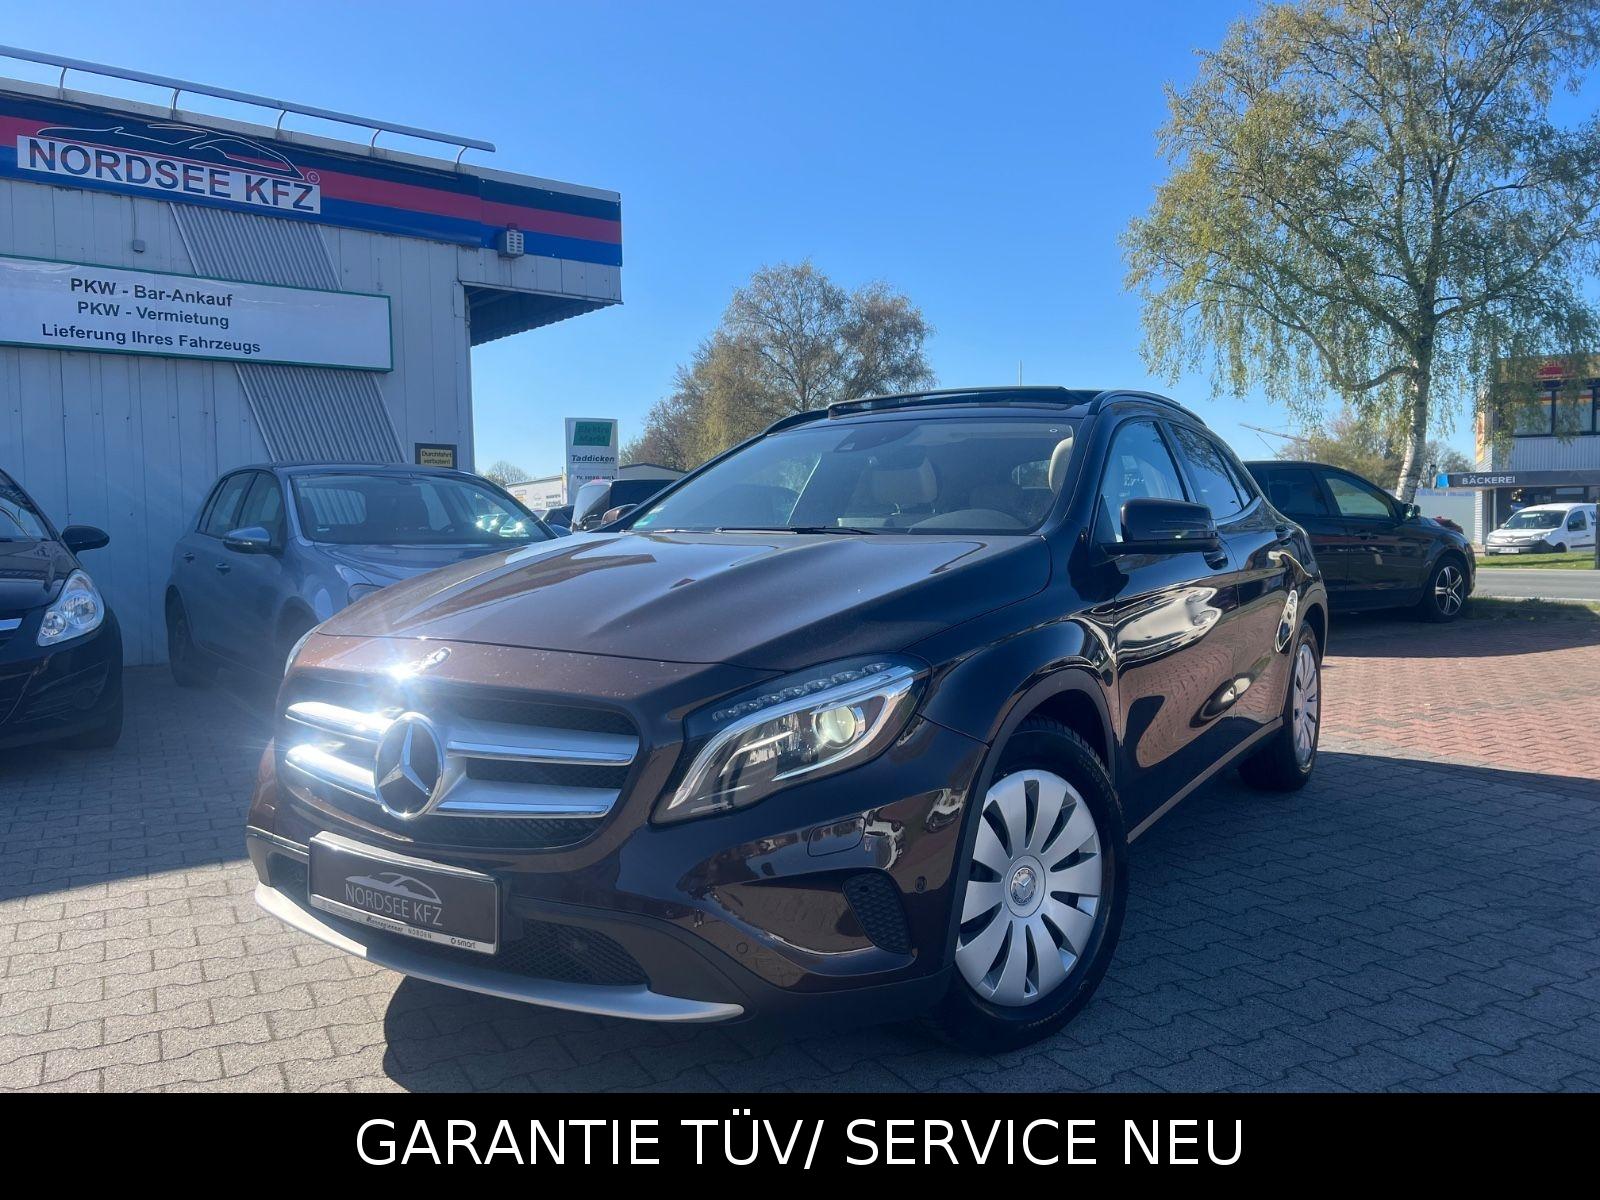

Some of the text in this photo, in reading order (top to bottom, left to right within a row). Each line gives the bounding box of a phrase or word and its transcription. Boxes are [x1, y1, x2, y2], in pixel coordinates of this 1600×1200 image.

[28, 138, 315, 212] NORDSEE KFZ
[70, 277, 117, 296] PKW
[134, 284, 233, 307] Bar-Ankauf
[77, 301, 120, 317] PKW
[136, 306, 230, 330] Vermietung
[41, 323, 261, 354] Lieferung Ihres Fahrzeugs
[571, 454, 615, 463] Taddicken
[1461, 475, 1516, 485] BÄCKEREI
[345, 883, 409, 919] NORDSEE
[413, 901, 443, 926] KFZ
[457, 938, 476, 949] smart
